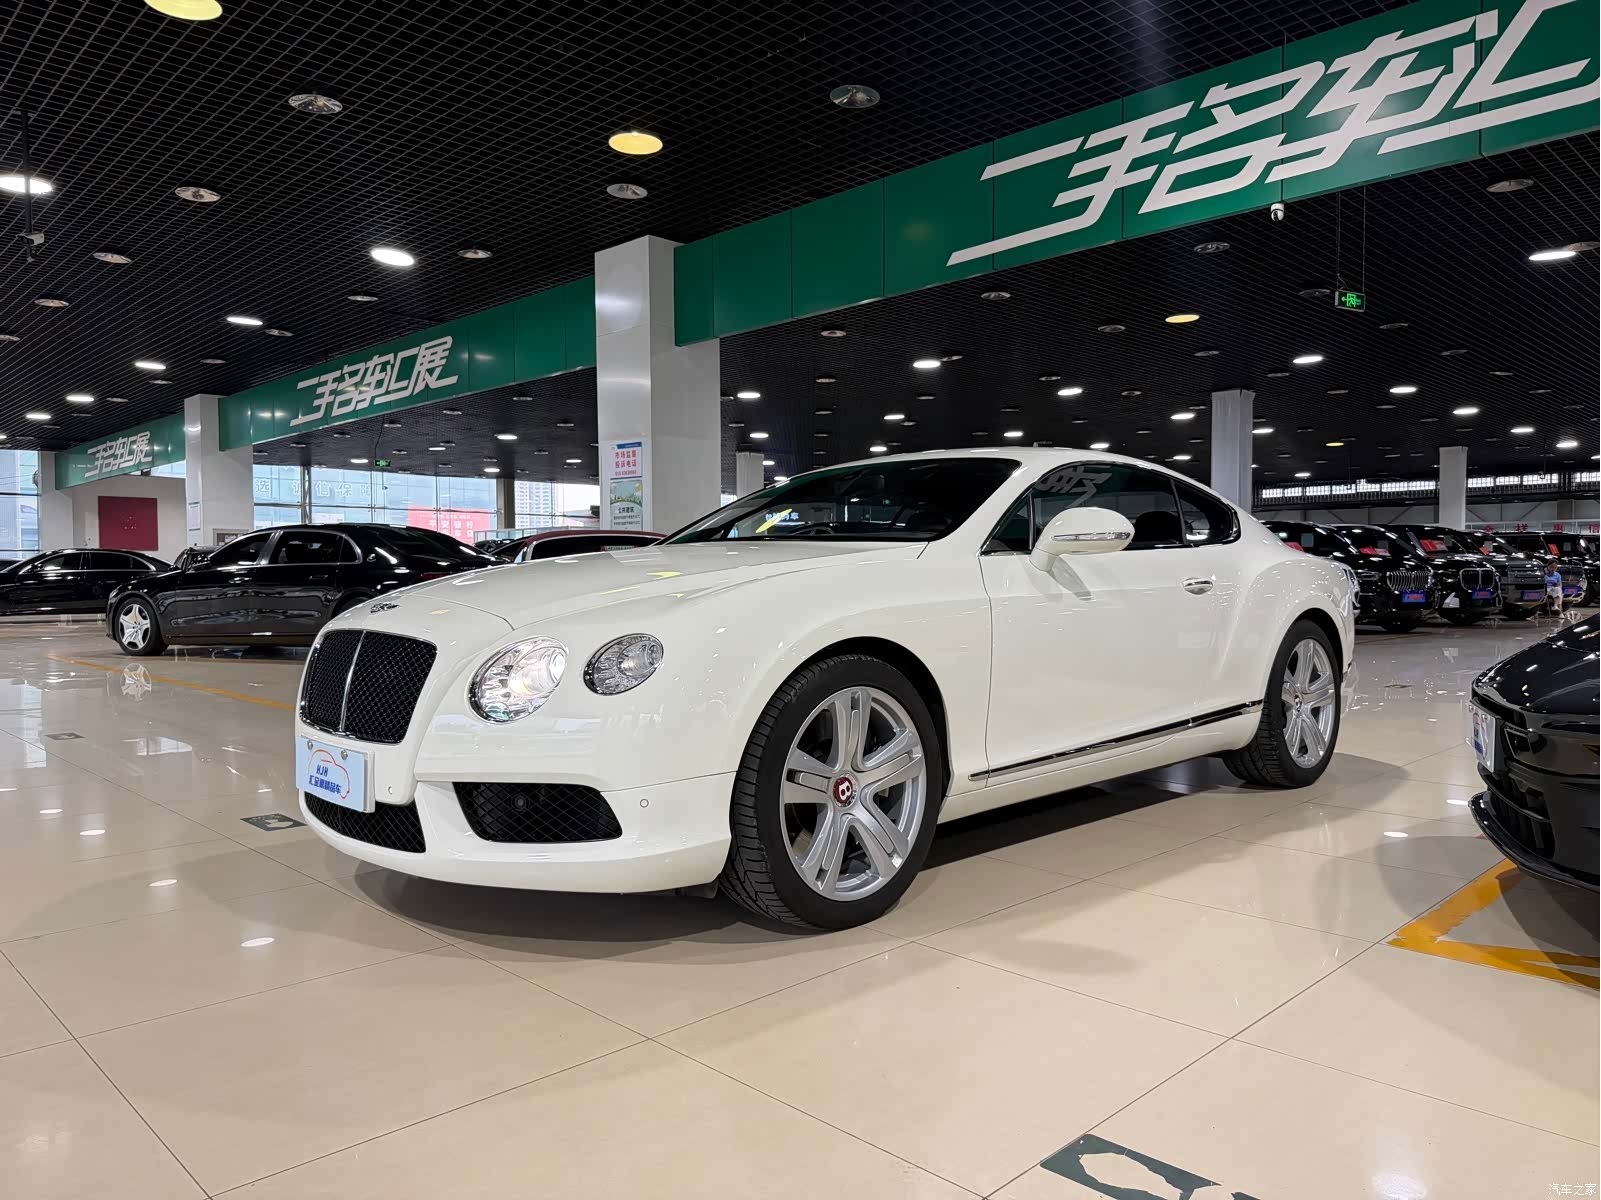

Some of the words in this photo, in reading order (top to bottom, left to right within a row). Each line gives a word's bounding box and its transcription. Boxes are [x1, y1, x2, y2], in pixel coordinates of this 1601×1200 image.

[289, 336, 459, 427] 二手名车汇展
[85, 431, 152, 477] 二手名车汇展
